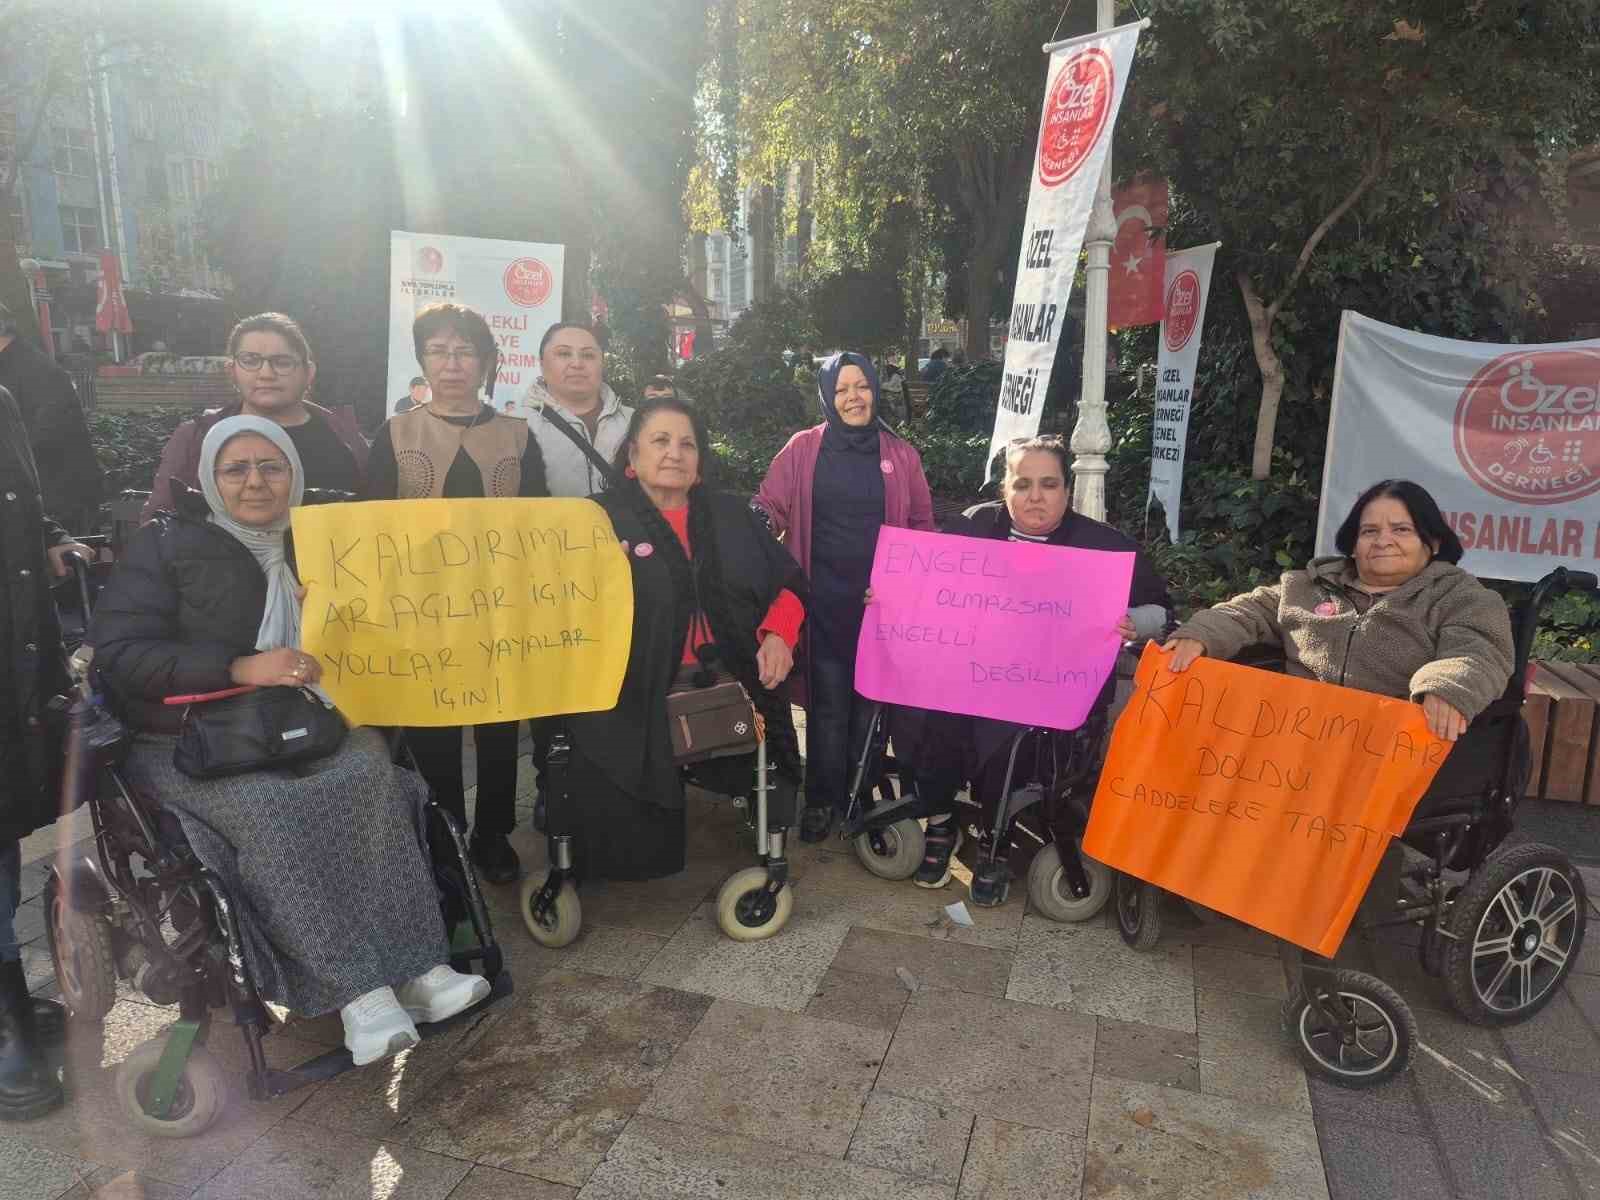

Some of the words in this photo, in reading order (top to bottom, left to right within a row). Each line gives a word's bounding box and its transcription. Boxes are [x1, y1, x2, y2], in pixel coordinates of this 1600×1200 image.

[487, 314, 528, 330] EKLİ
[498, 334, 520, 348] YE
[496, 353, 535, 368] ARIM
[496, 371, 521, 385] NU
[1487, 462, 1592, 491] DERNEĞİ
[1440, 511, 1585, 558] NSANLAR
[329, 526, 611, 589] KALDIRIMLA
[884, 543, 1008, 578] ENGEL
[936, 588, 1073, 617] OLMAZSAN
[324, 648, 462, 685] YOLLAR
[478, 629, 600, 667] YAYALAR
[1140, 669, 1443, 766] KALDIRIMLAR
[1196, 747, 1312, 792] DOLDU
[1110, 777, 1266, 822] CADDELERE
